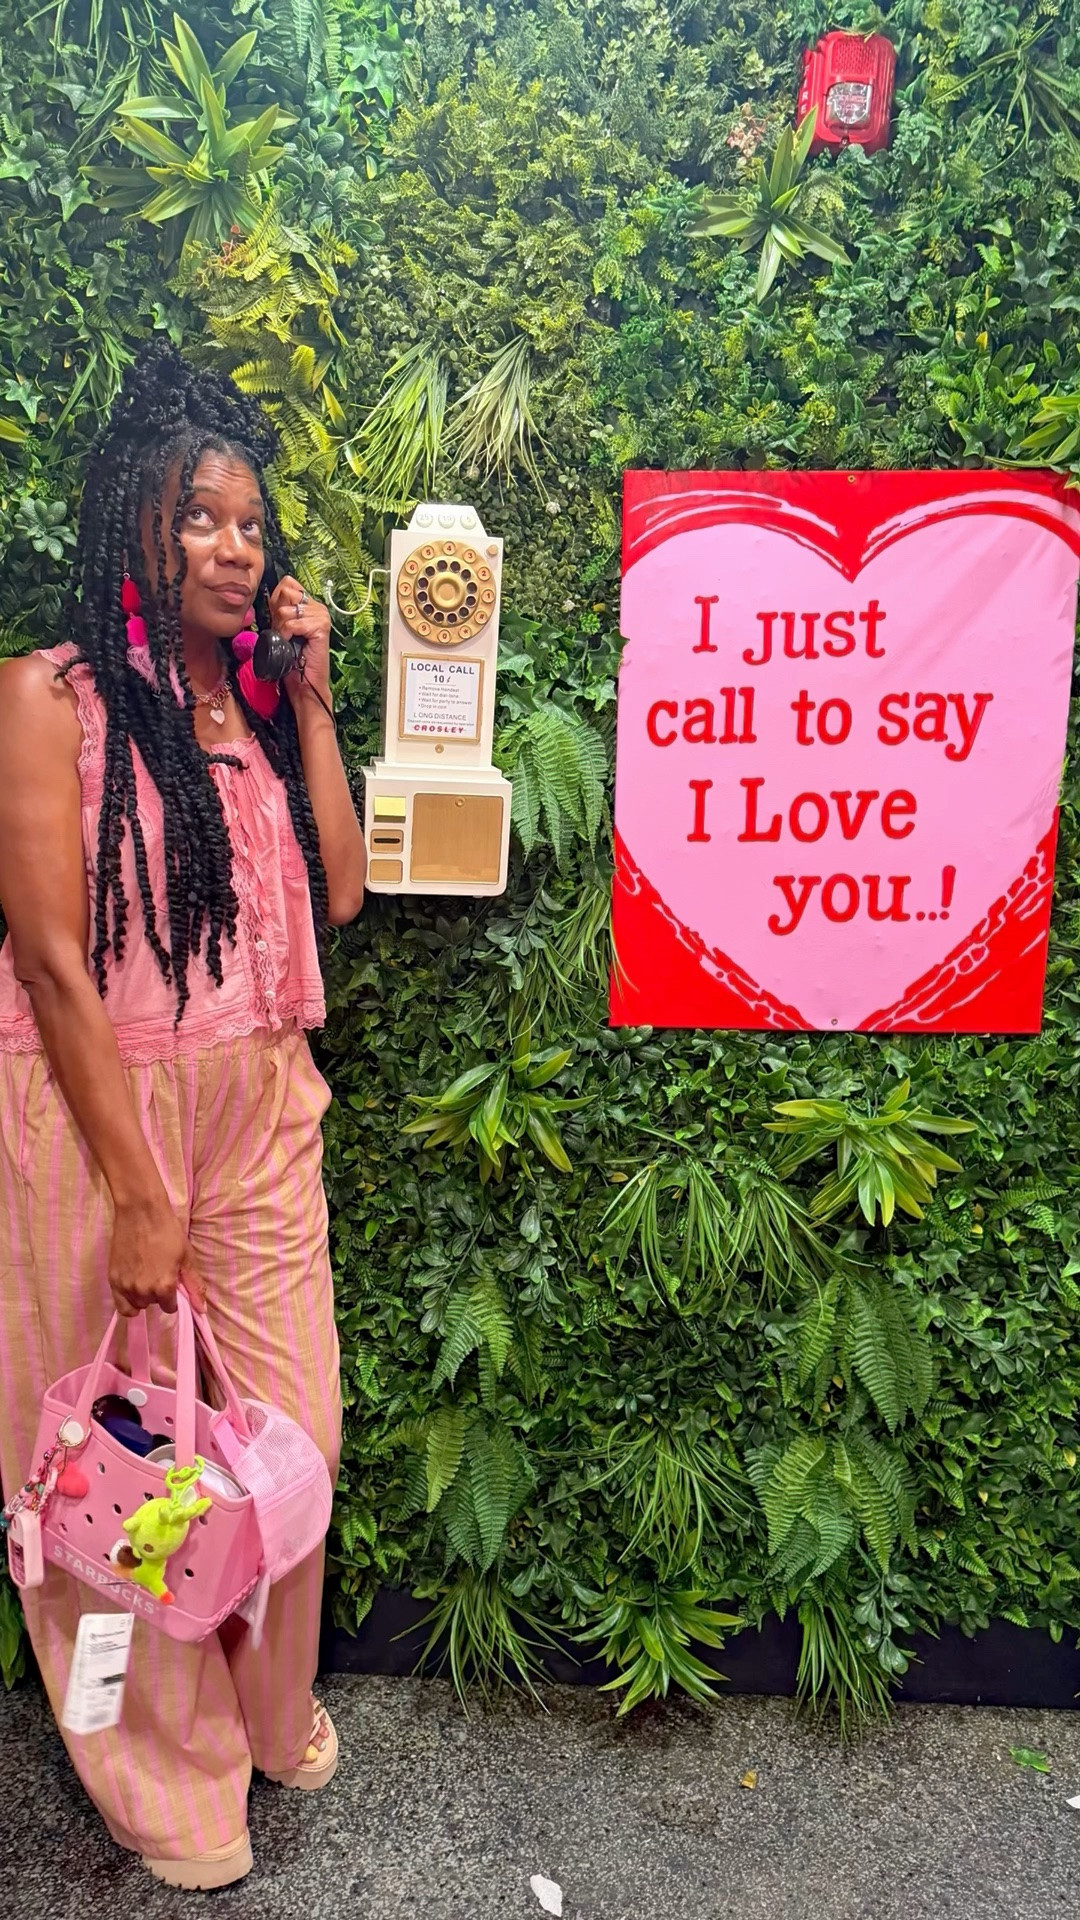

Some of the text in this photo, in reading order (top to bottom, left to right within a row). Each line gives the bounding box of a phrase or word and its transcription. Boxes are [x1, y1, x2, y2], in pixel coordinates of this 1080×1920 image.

[800, 65, 810, 115] FIRE
[692, 595, 886, 666] I just
[410, 662, 474, 674] LOCAL CALL
[414, 724, 464, 733] CROSLEY
[646, 686, 993, 762] call to say
[687, 777, 918, 843] I Love
[54, 1545, 155, 1614] STARBUCKS
